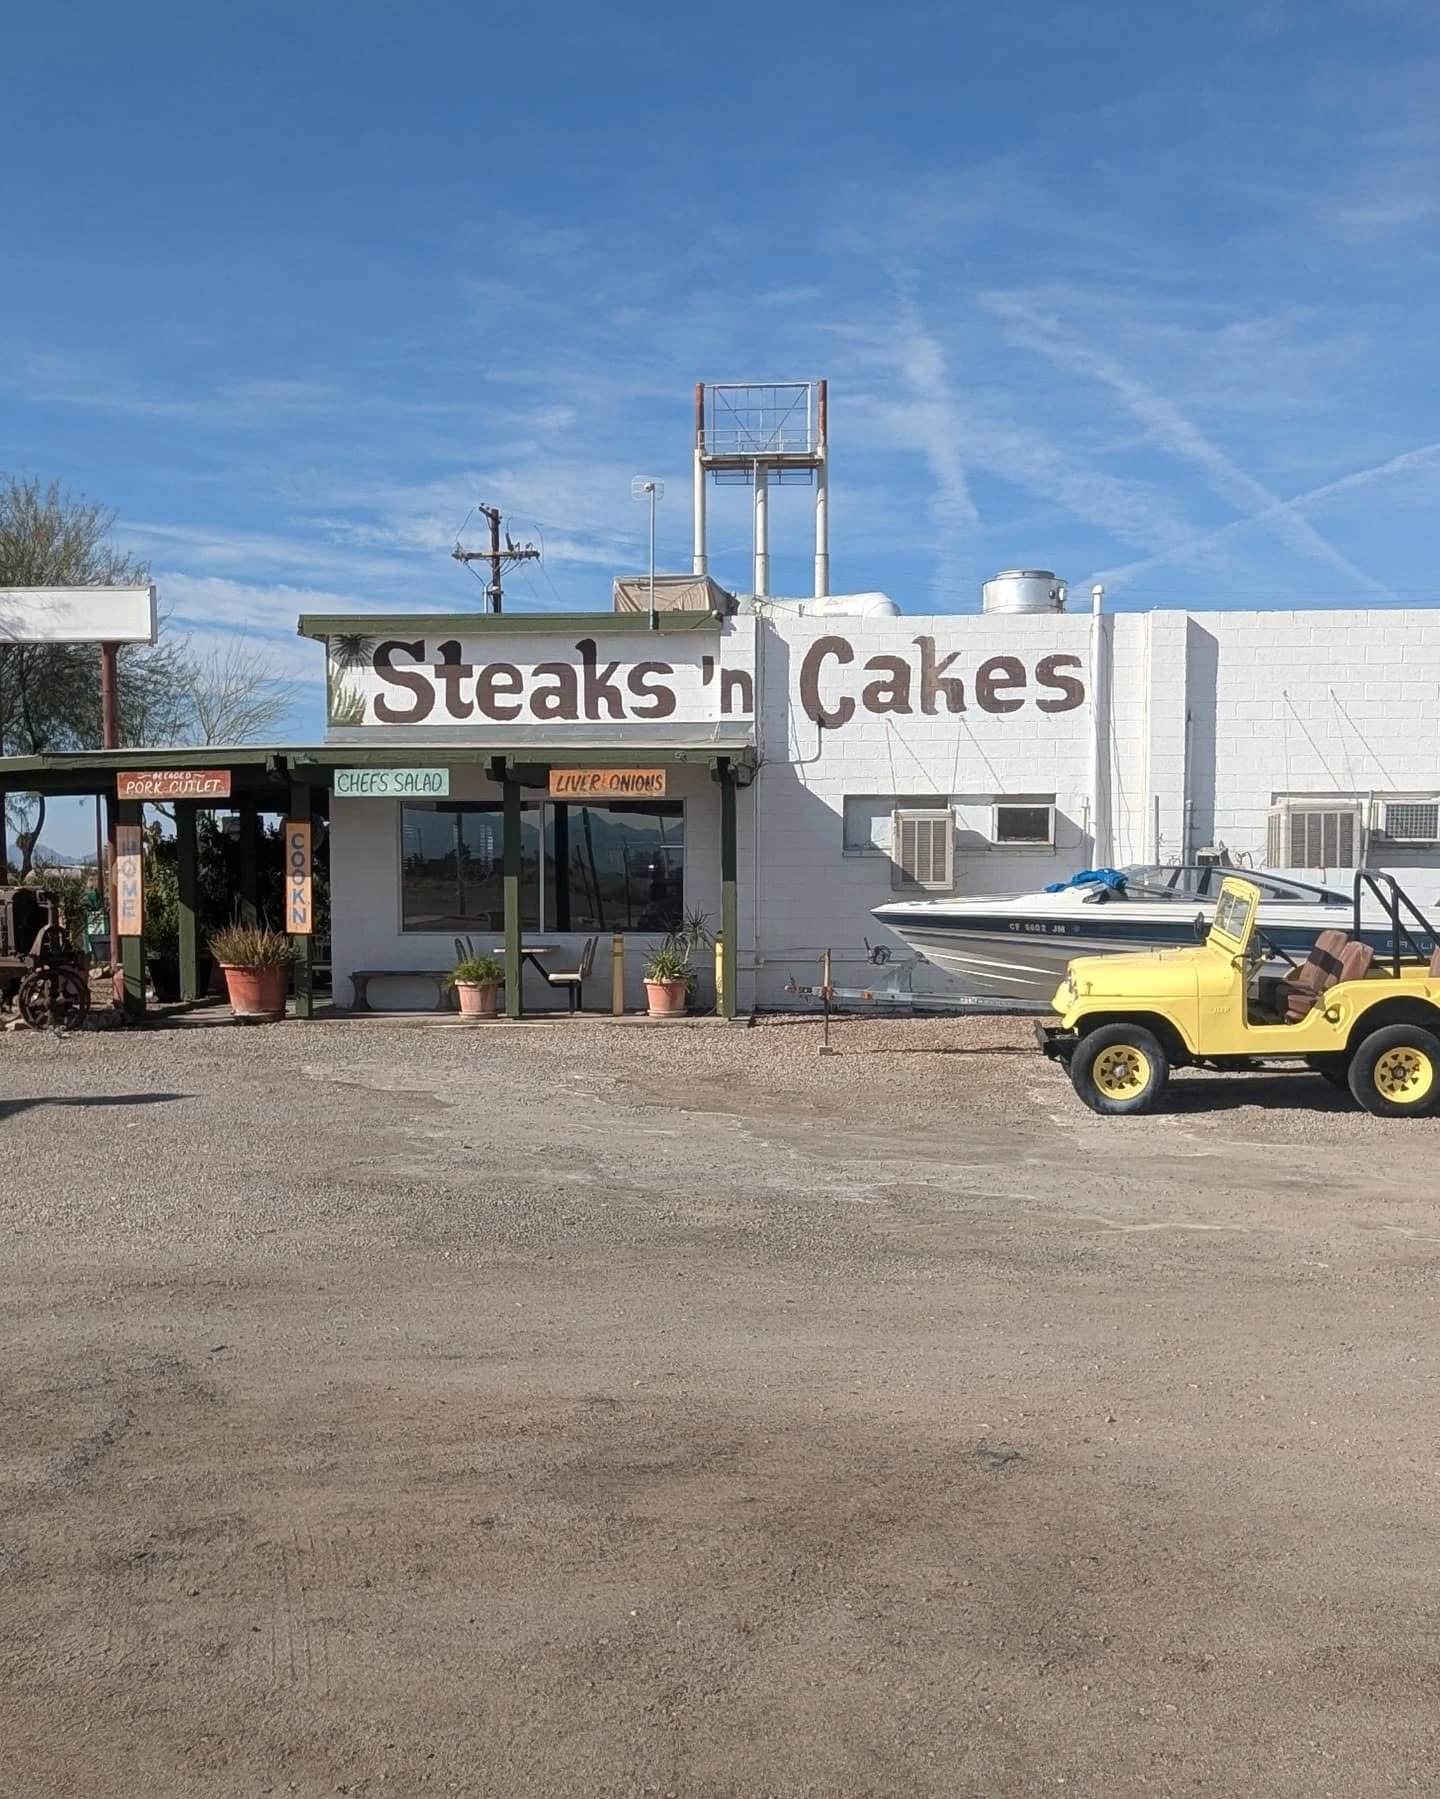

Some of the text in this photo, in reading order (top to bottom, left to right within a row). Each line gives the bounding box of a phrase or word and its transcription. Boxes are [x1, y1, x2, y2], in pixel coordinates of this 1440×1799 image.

[372, 638, 677, 724] Steaks
[800, 635, 1085, 729] Cakes
[126, 779, 221, 794] PORK CUTLET
[338, 772, 443, 793] CHEFS SALAD
[556, 773, 601, 793] LIVER
[609, 773, 663, 793] ONIONS
[122, 841, 138, 917] HOME
[291, 833, 307, 924] COOKN
